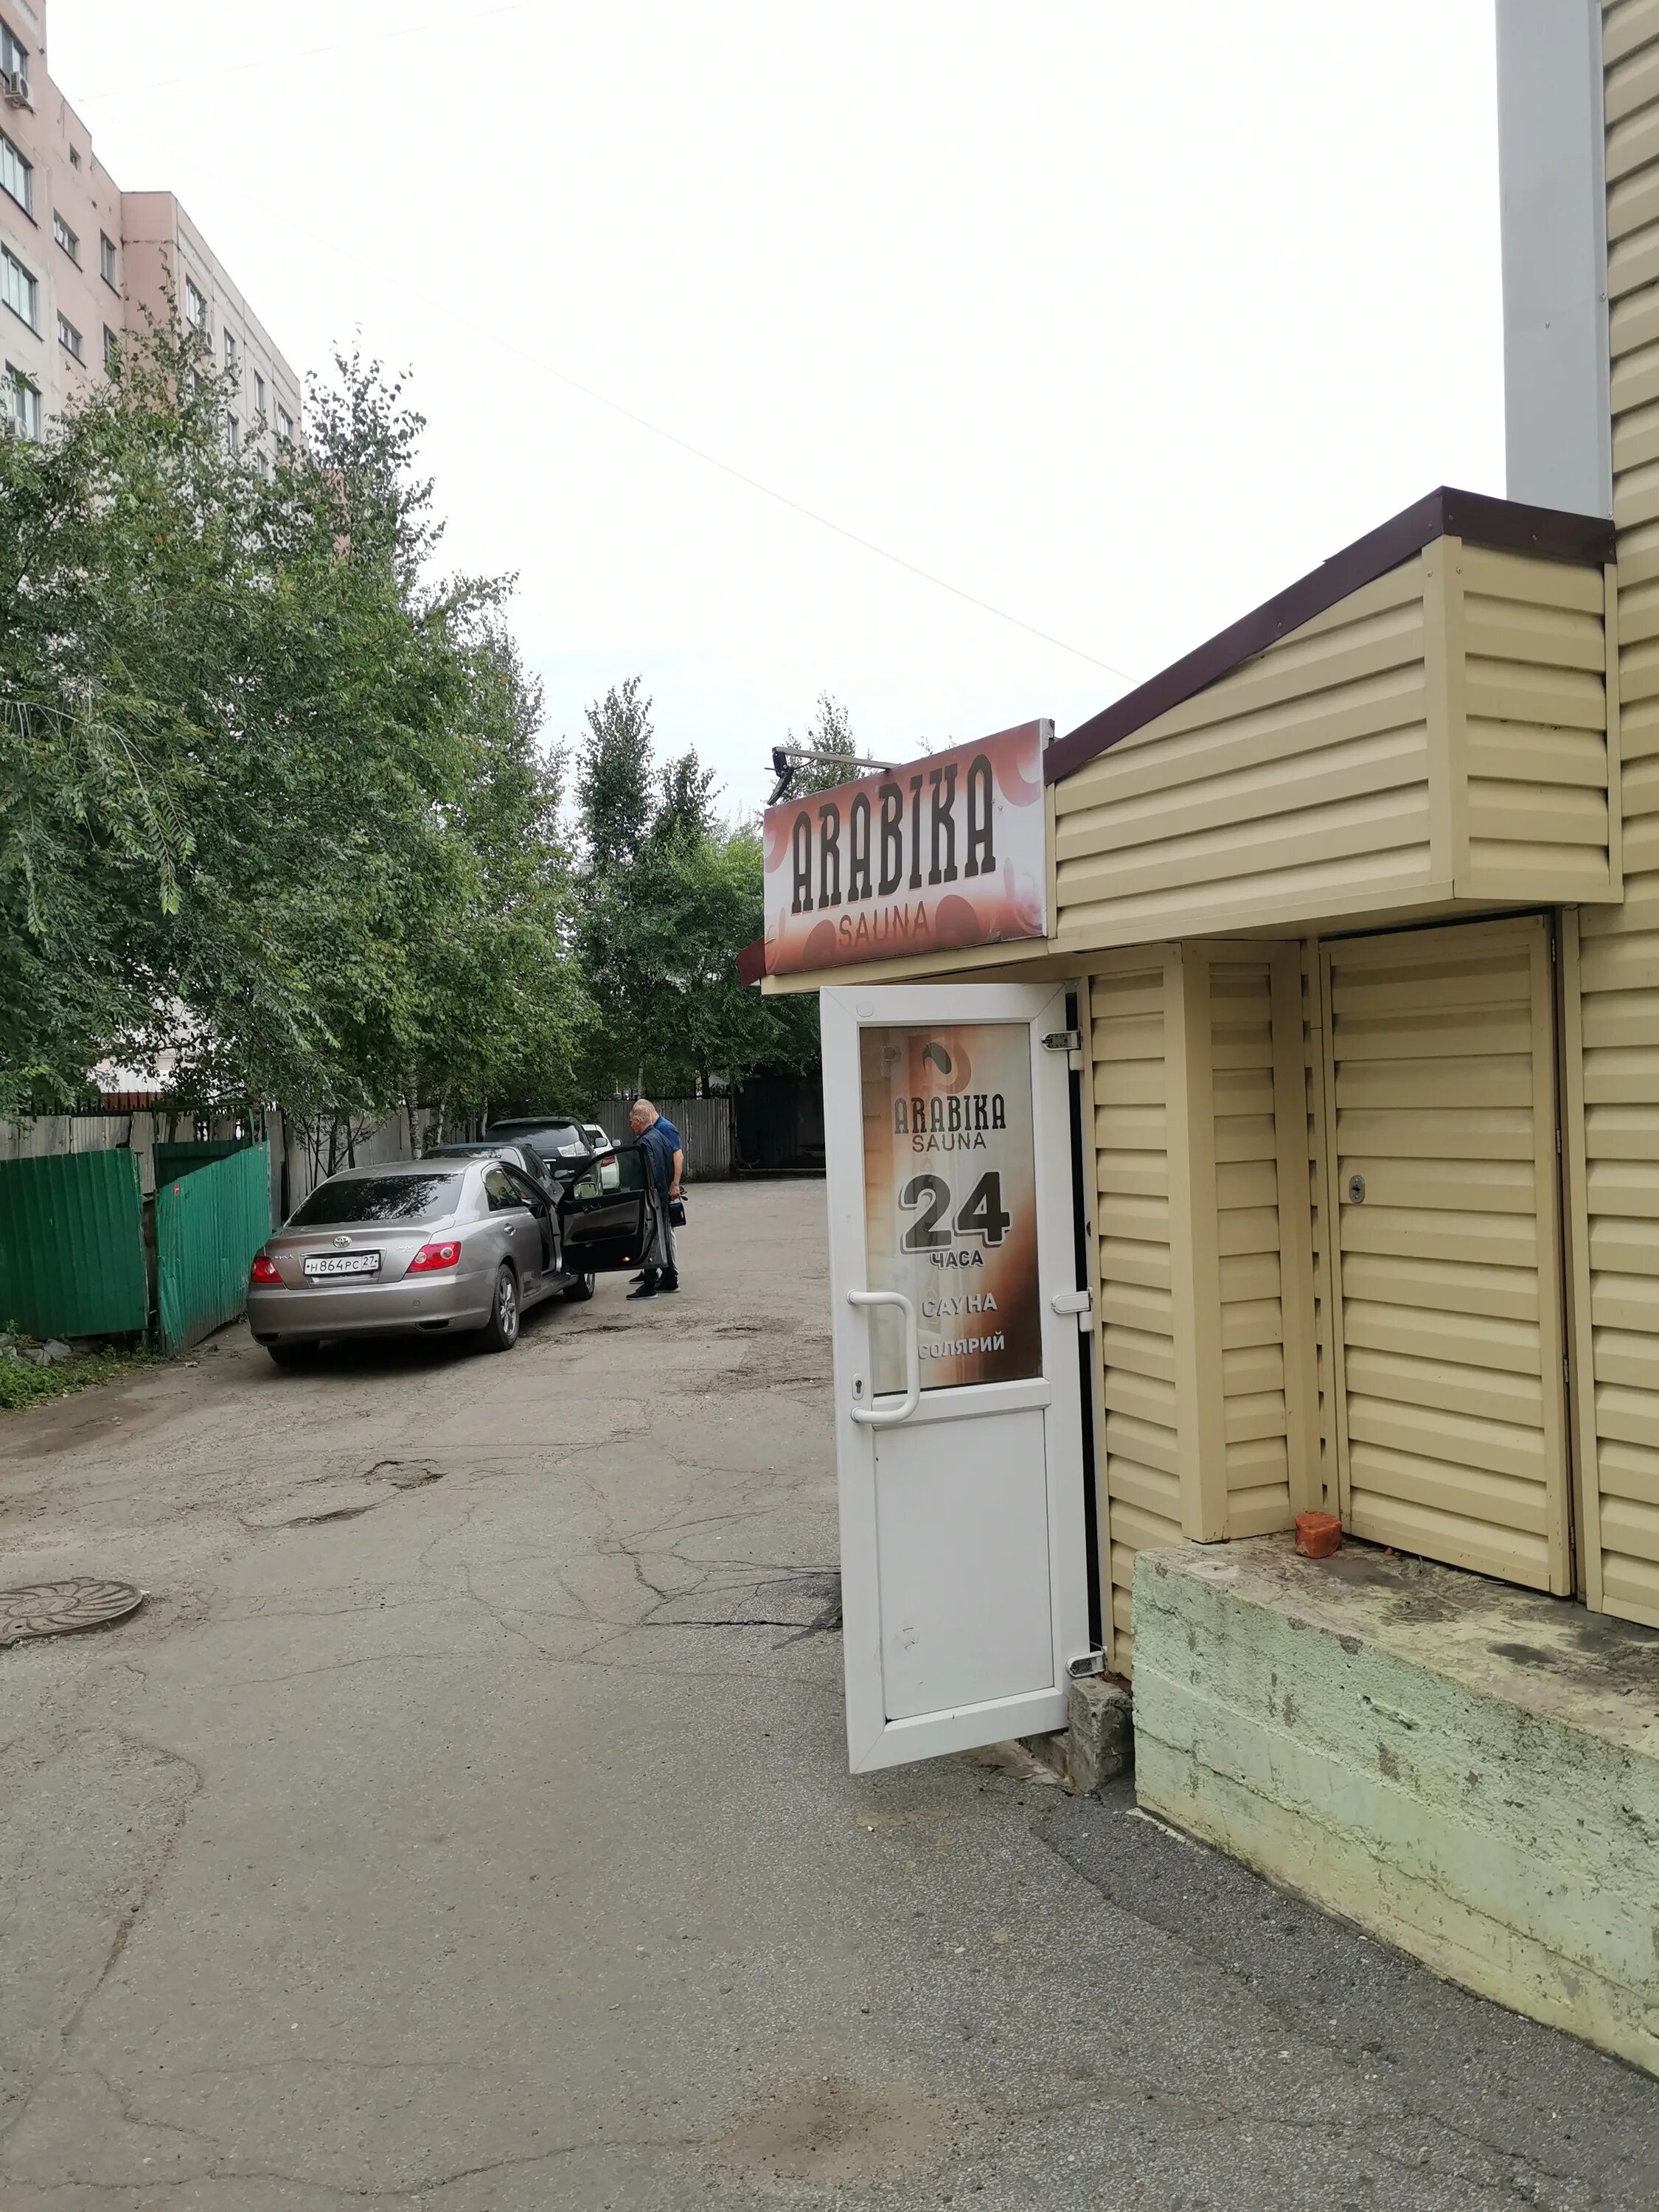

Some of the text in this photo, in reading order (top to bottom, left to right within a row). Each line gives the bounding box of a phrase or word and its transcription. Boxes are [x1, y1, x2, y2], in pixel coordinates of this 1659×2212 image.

[791, 754, 996, 914] ARABIKA
[838, 900, 929, 948] SAUNA
[894, 1093, 1006, 1134] ARABIKA
[911, 1132, 987, 1152] SAUNA
[900, 1170, 1012, 1252] 24
[310, 1256, 375, 1272] Н864РС 27
[931, 1249, 984, 1269] ЧАСА
[922, 1292, 998, 1318] САУНА
[918, 1331, 1005, 1359] СОЛЯРИЙ
